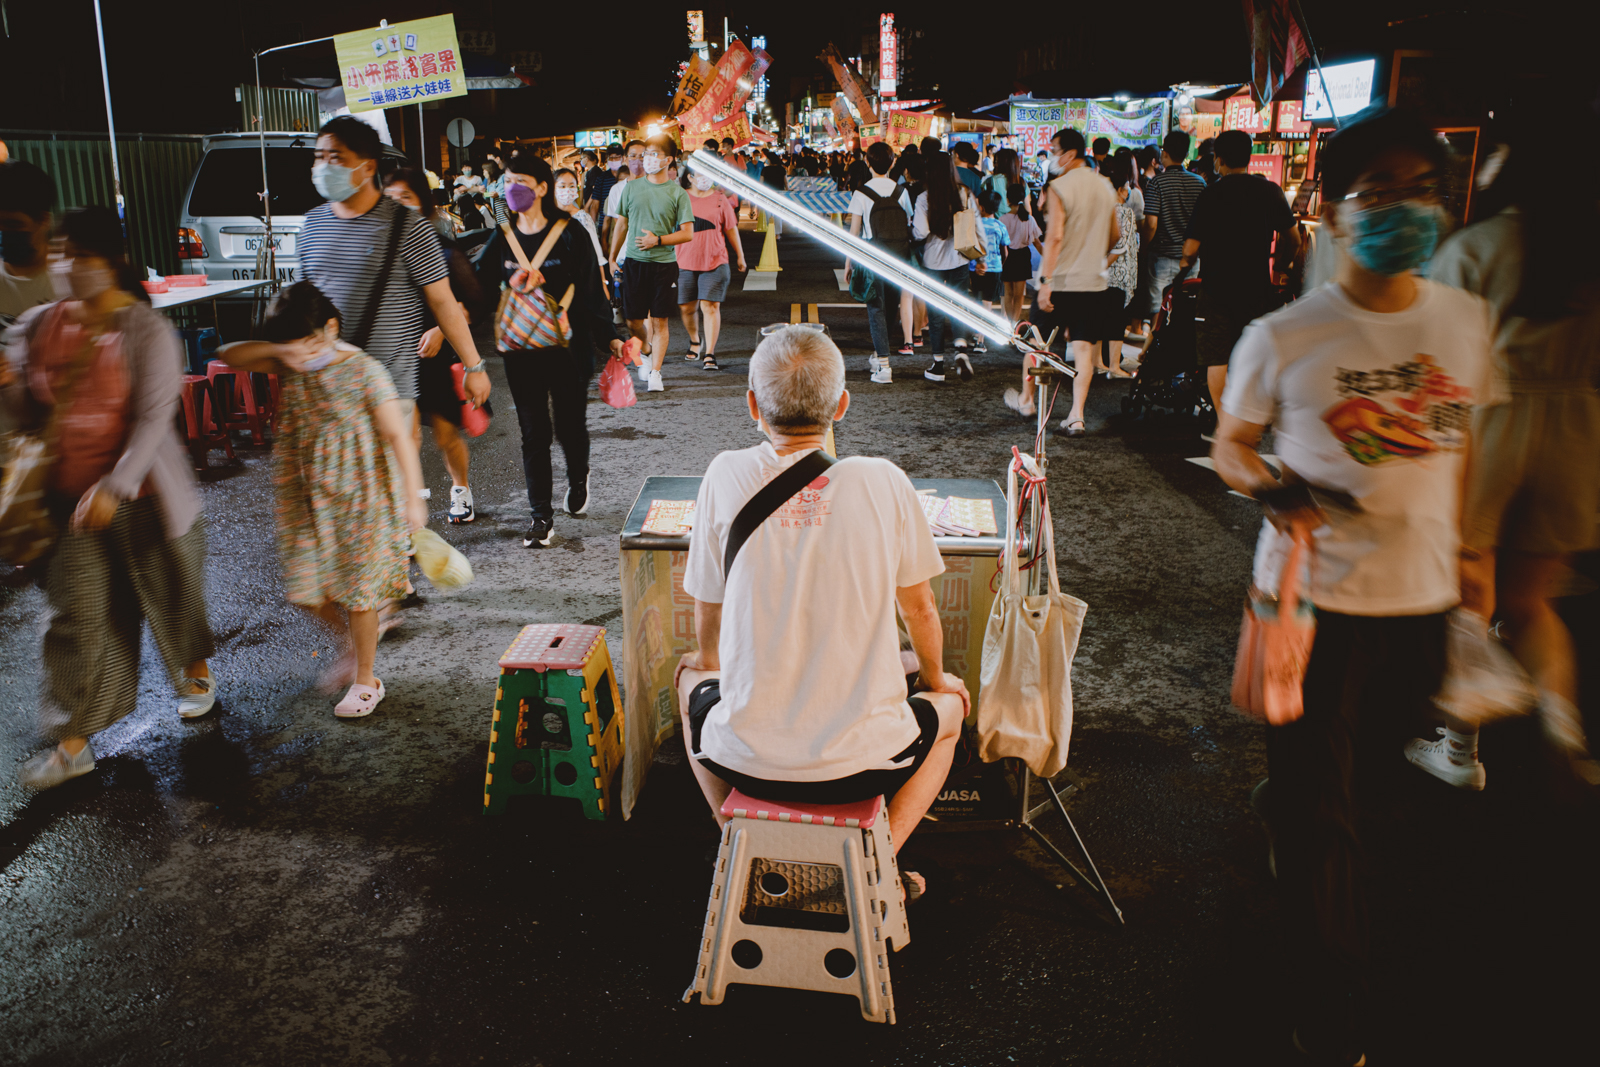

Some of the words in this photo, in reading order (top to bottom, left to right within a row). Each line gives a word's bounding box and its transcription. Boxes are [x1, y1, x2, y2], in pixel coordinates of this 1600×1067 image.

[347, 48, 457, 90] 小米麻將賓果
[358, 78, 453, 106] 一連線送大娃娃
[1015, 107, 1061, 121] 逛文化路
